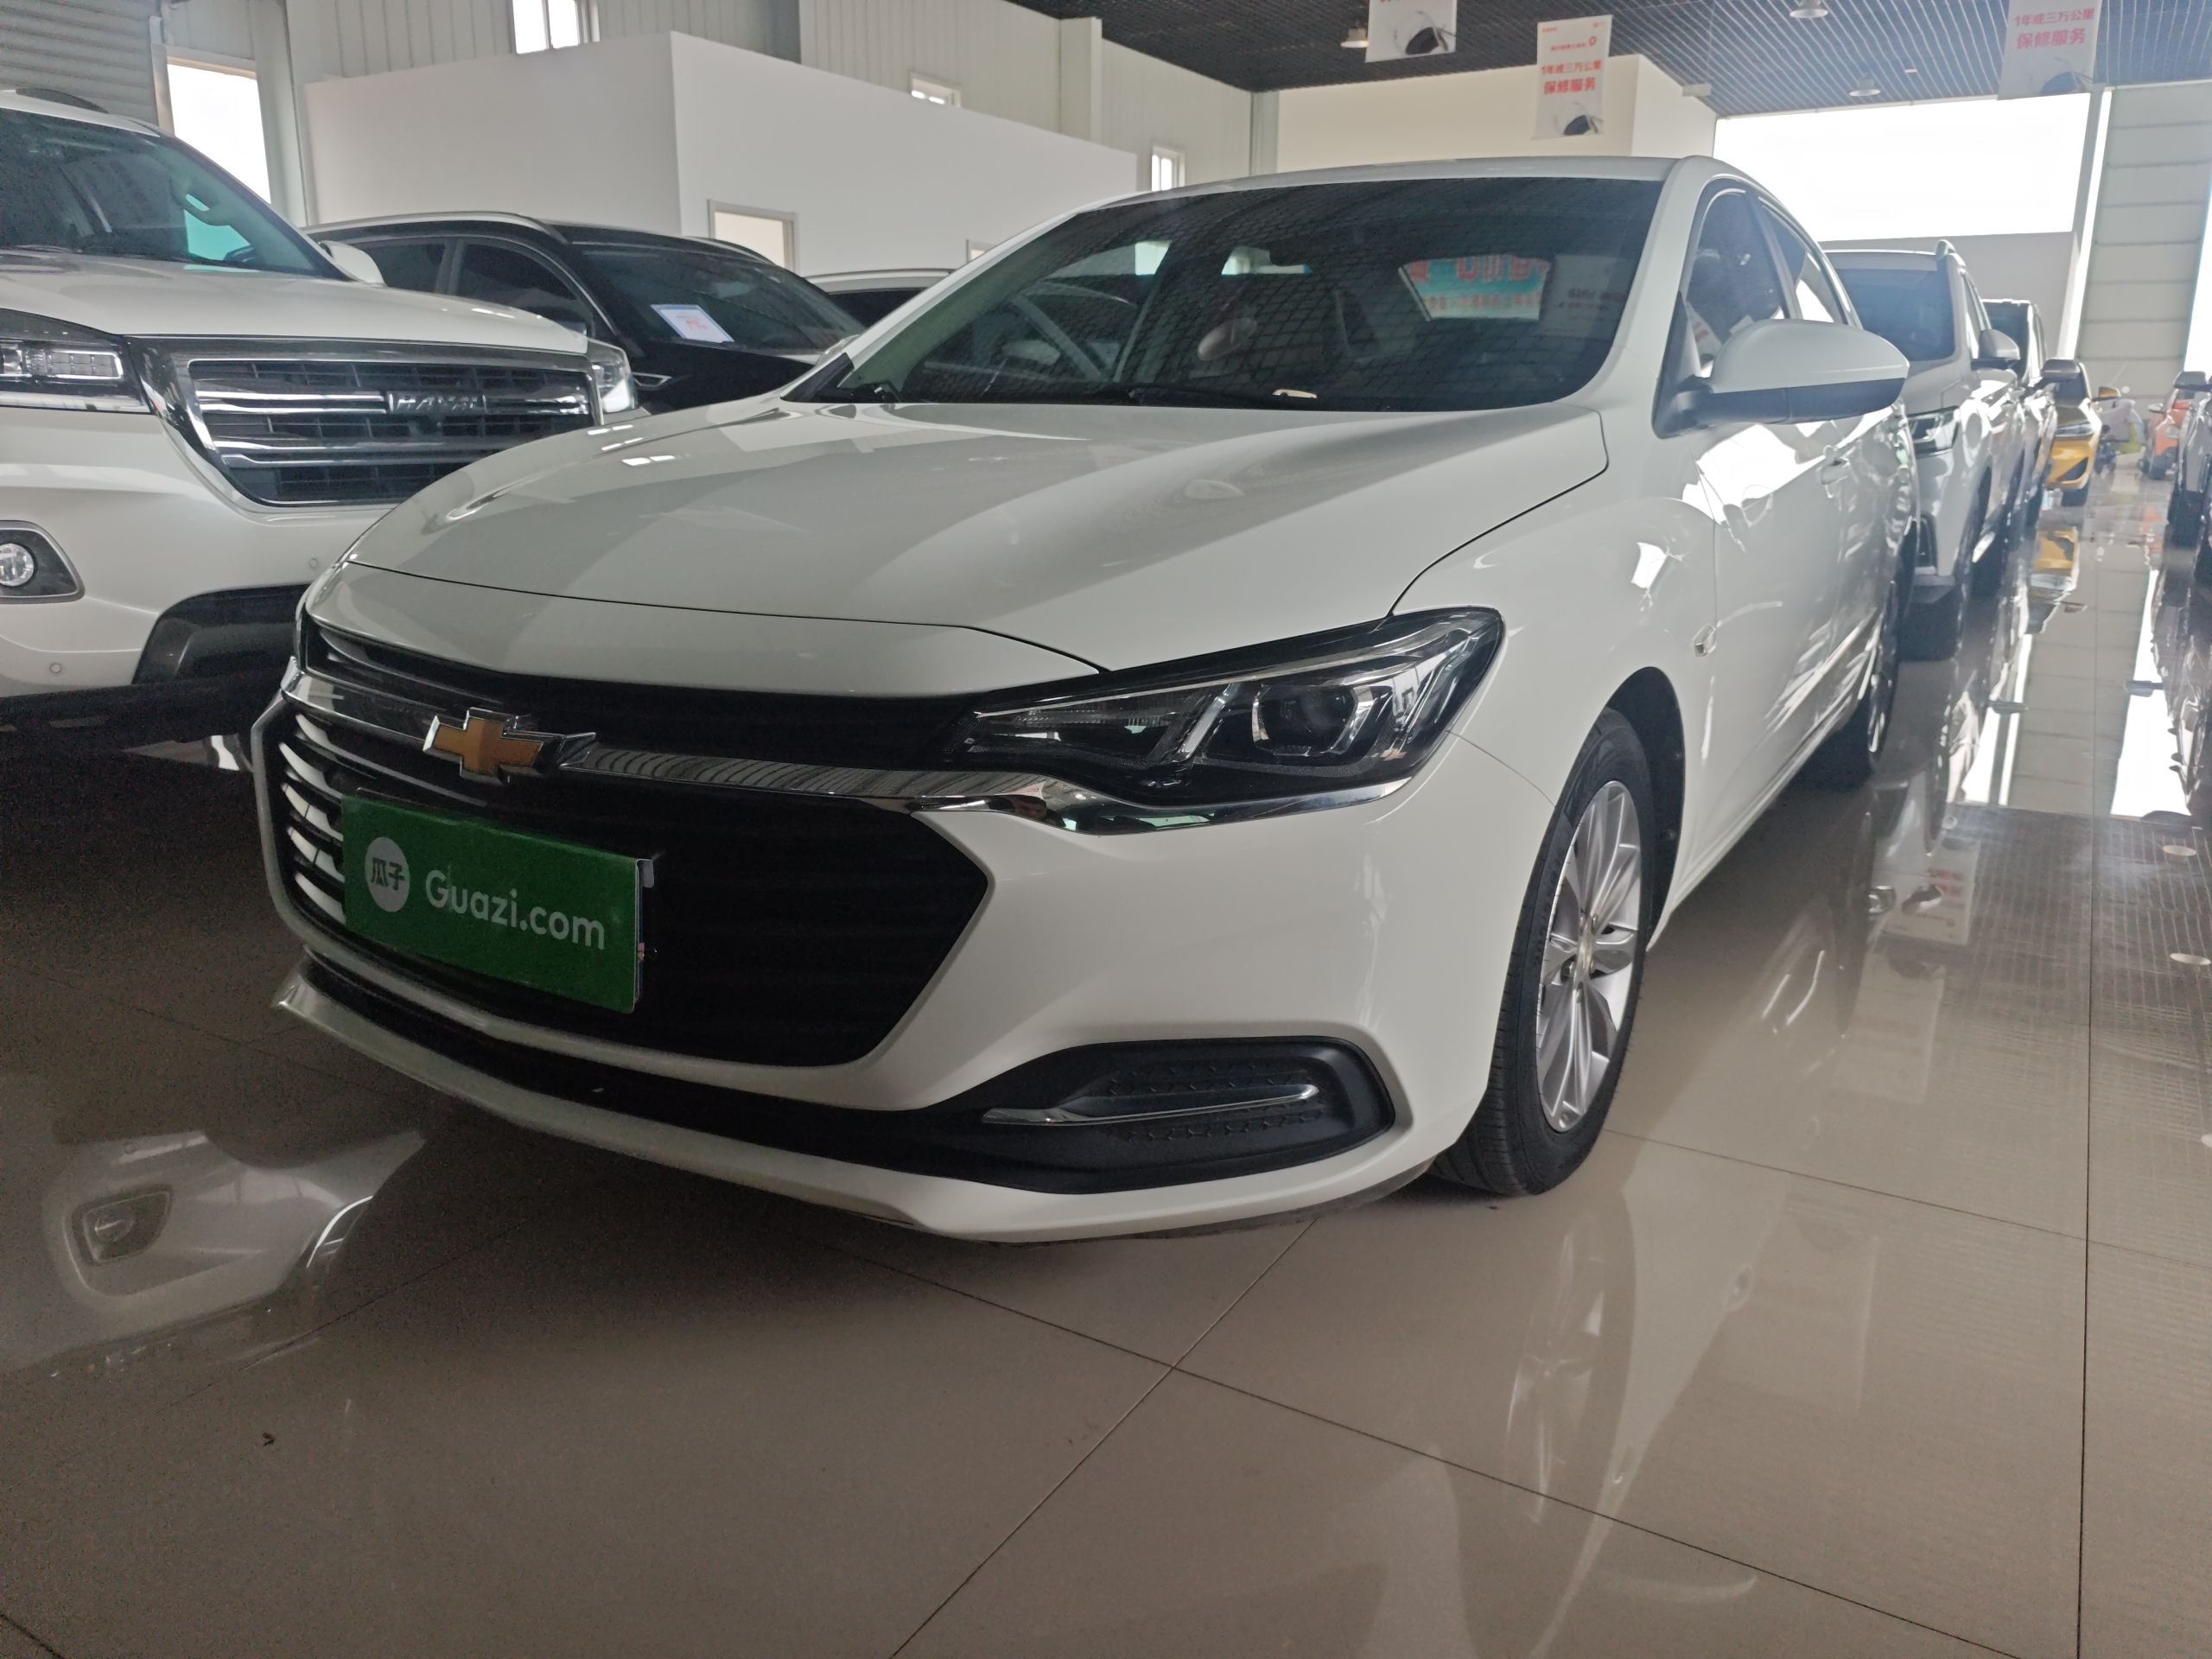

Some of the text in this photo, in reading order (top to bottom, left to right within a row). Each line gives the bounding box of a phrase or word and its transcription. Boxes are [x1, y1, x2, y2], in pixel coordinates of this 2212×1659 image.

[2017, 28, 2086, 49] 保修服务
[1544, 77, 1596, 94] 保修服务
[397, 395, 480, 411] HAVAL
[371, 856, 405, 891] 瓜子
[425, 868, 606, 950] Guazi.com
